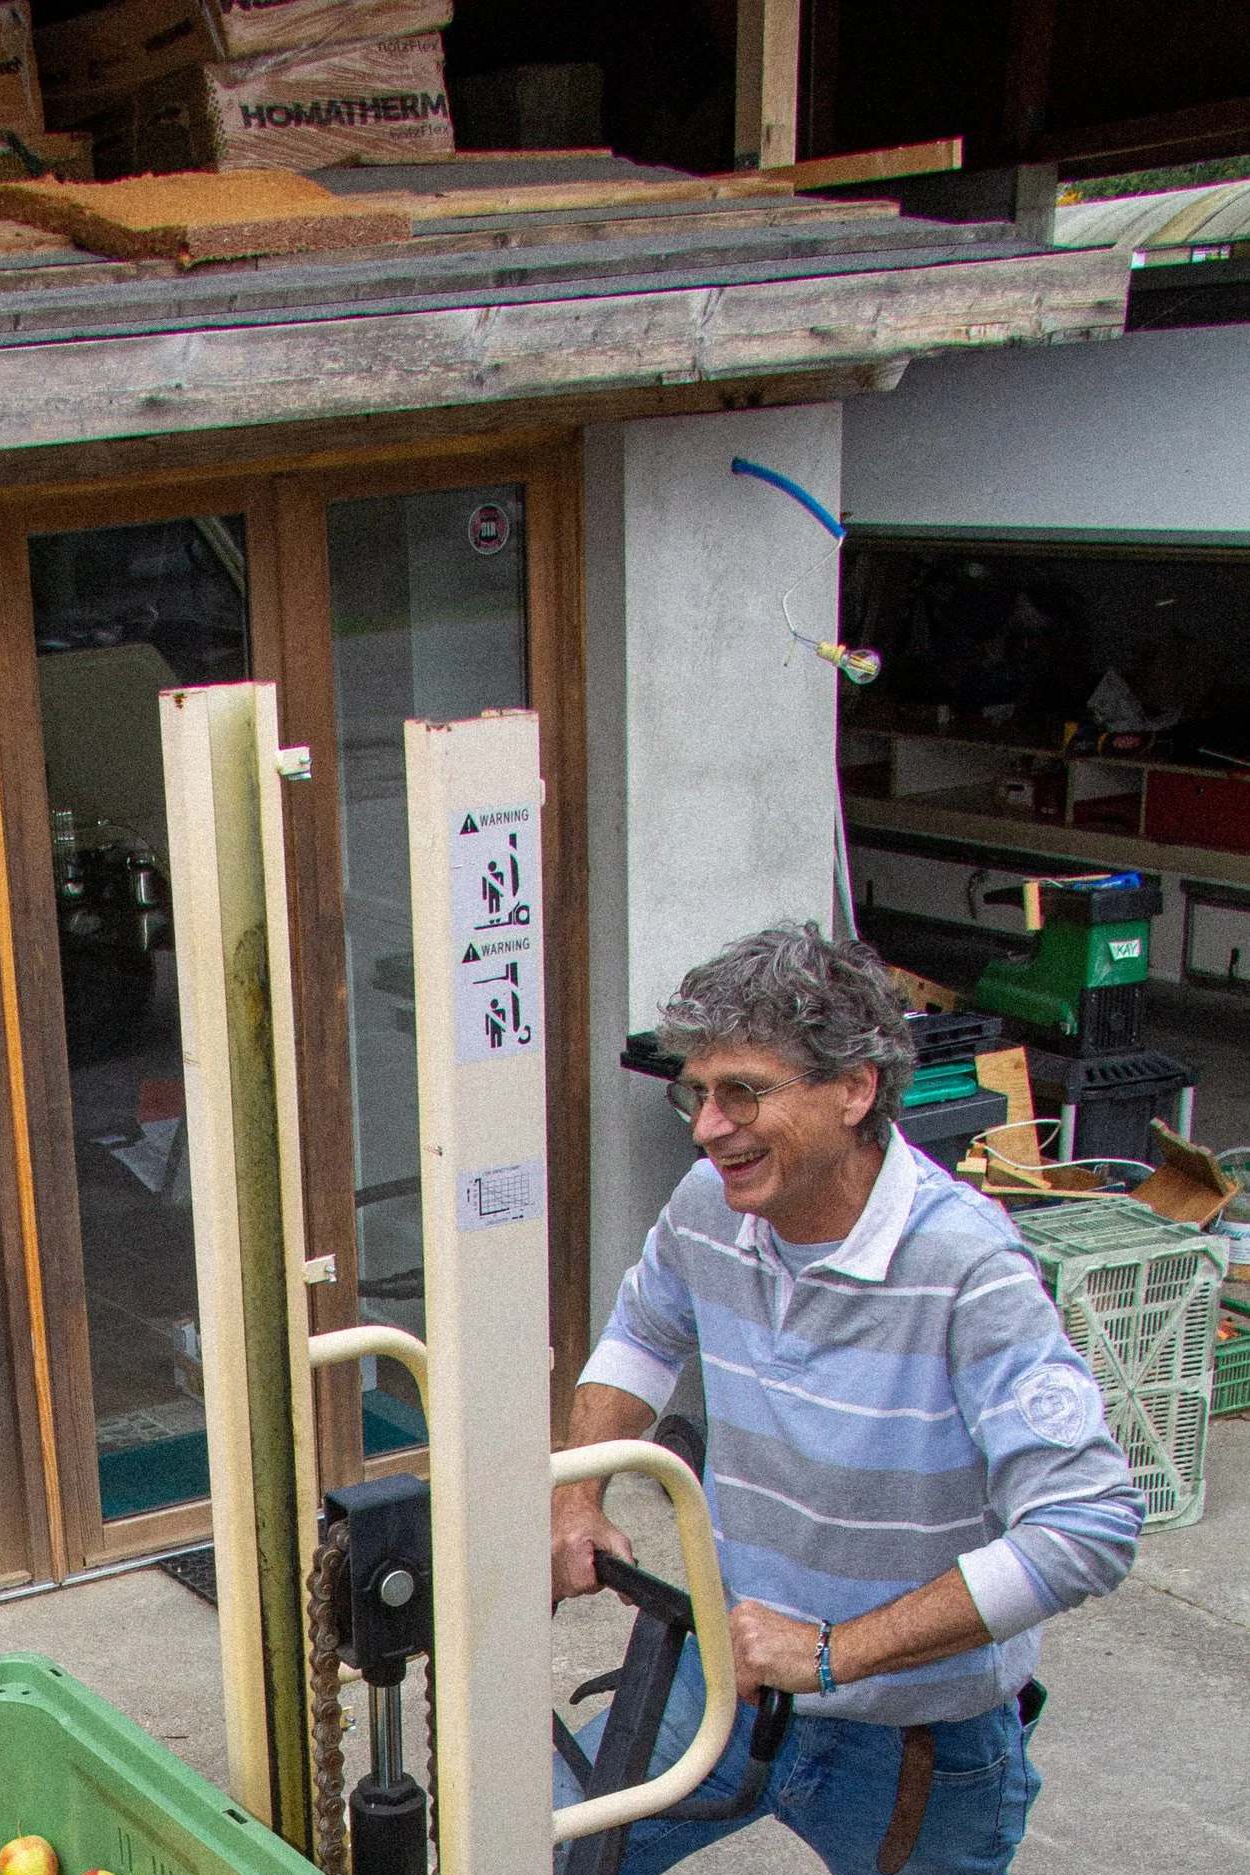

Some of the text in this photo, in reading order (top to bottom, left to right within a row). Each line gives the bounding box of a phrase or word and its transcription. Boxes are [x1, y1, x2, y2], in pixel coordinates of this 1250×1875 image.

[238, 92, 450, 129] HOMATHERM
[480, 809, 529, 827] WARNING
[481, 938, 530, 956] WARNING
